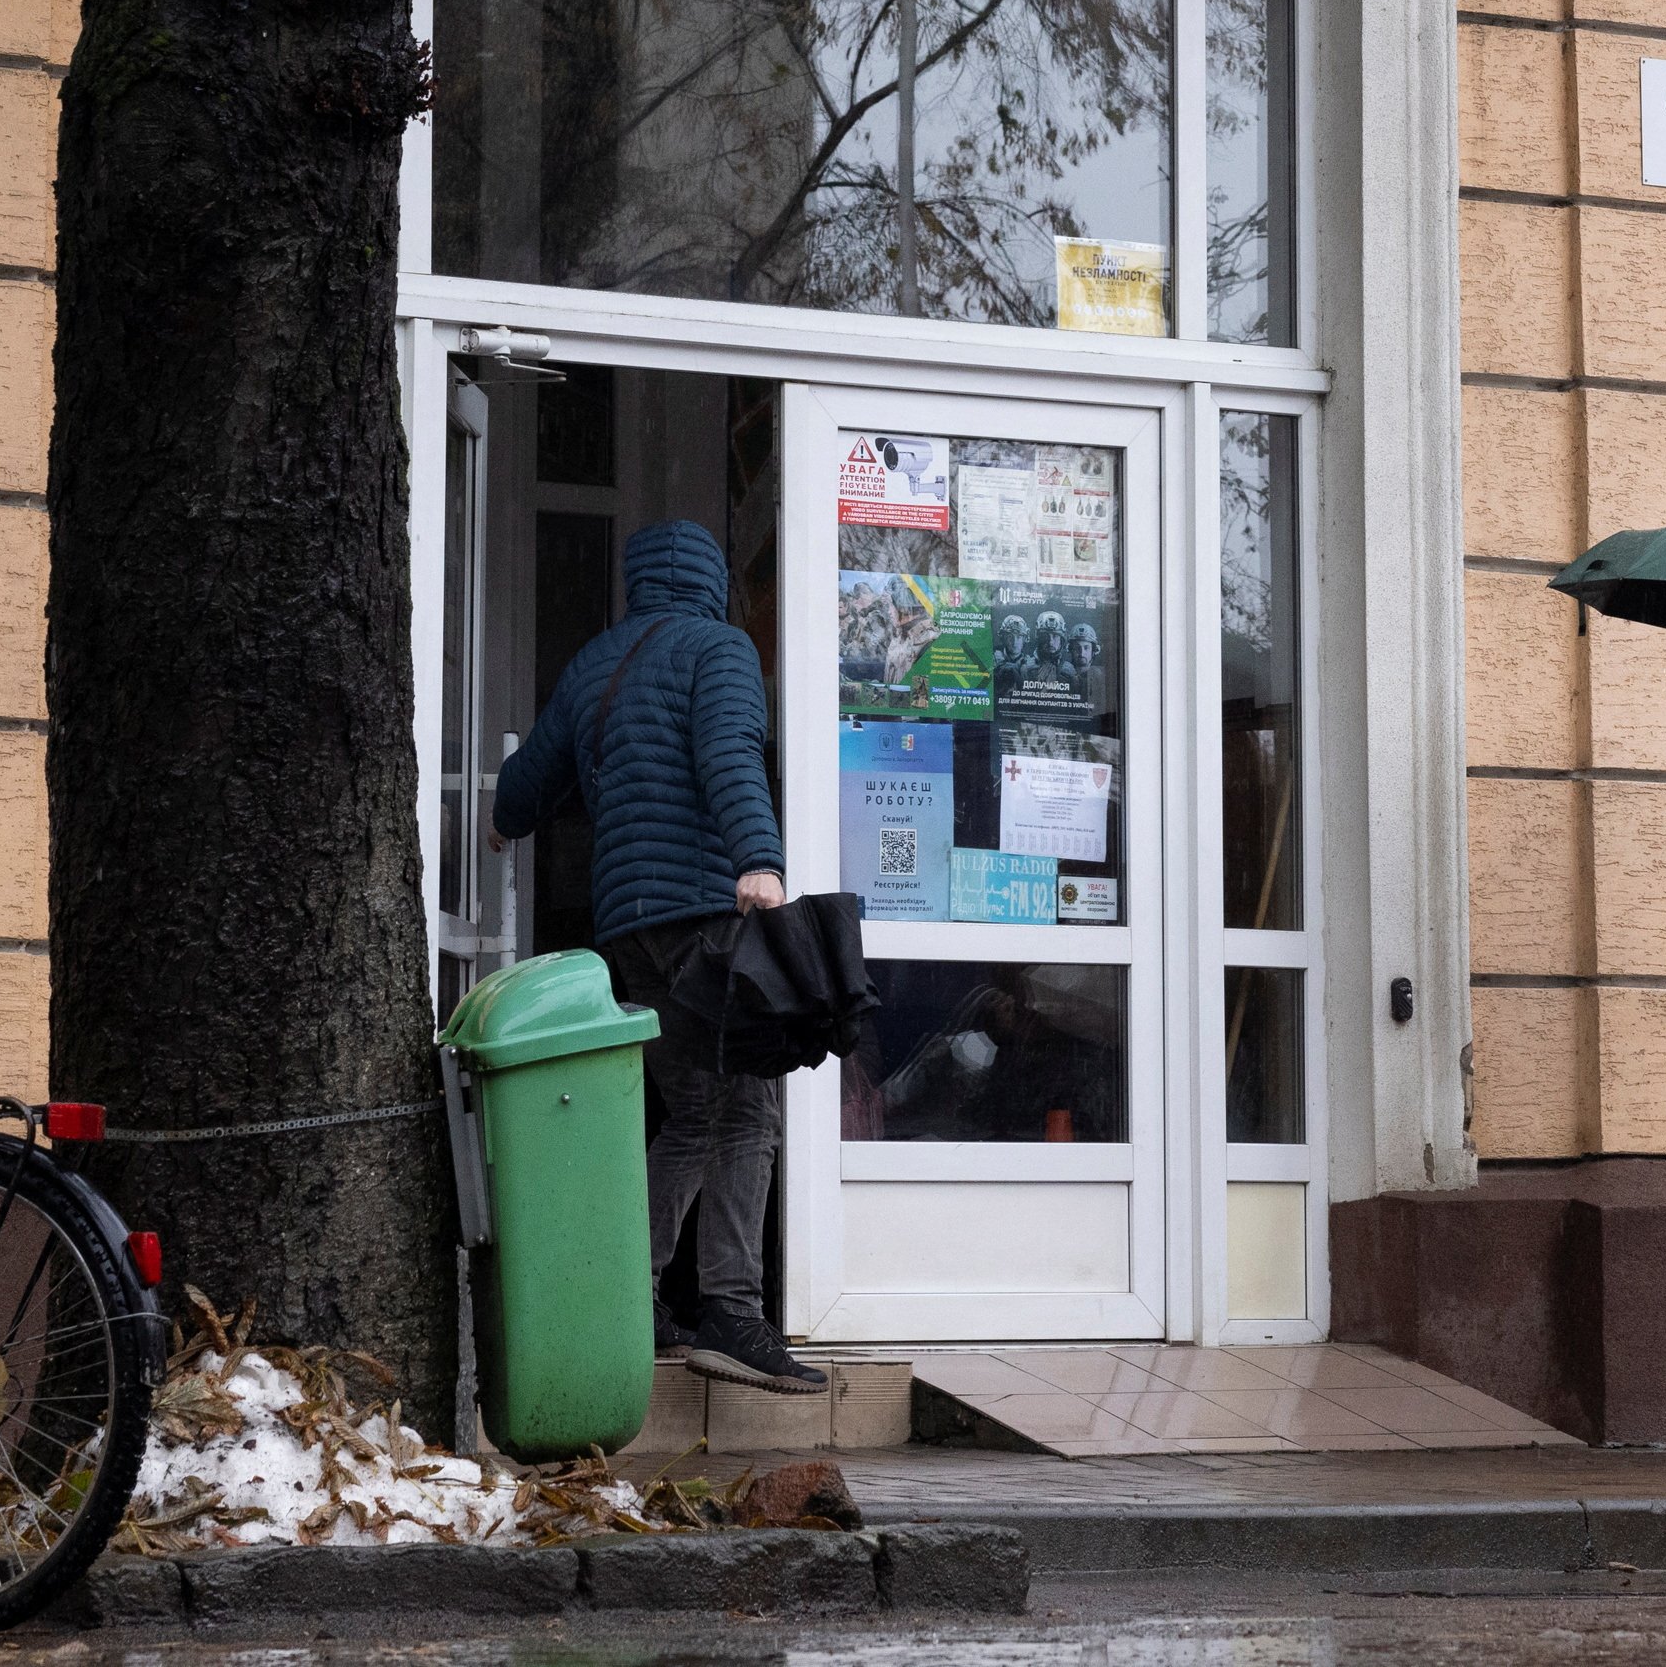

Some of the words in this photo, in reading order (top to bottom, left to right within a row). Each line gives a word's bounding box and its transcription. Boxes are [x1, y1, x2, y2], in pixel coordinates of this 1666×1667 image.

[1093, 254, 1127, 267] ПУНКТ
[1073, 266, 1147, 283] НЕЗЛАМНОСТІ
[840, 464, 885, 476] УВАГА
[840, 475, 885, 484] ATTENTION
[840, 482, 885, 491] FIGYELEM
[840, 489, 885, 498] ВНИМАНИЕ
[940, 611, 982, 620] ЗАПРОШУЄМО
[940, 619, 986, 629] БЕЗКОШТОВНЕ
[940, 627, 974, 636] НАВЧАННЯ
[1023, 680, 1070, 691] ДОЛУЧАЙСЯ
[930, 695, 957, 704] +38097
[958, 696, 972, 705] 717
[972, 697, 991, 706] 0419
[865, 780, 932, 792] ШУКАЄШ
[865, 795, 933, 807] РОБОТУ?
[882, 815, 913, 824] Скануй!
[952, 853, 1006, 873] PULZUS
[1010, 856, 1056, 876] RÁDIÓ
[874, 881, 921, 891] Реєструйся!
[1087, 883, 1108, 892] УВАГА!
[896, 898, 927, 906] необхідну
[1010, 881, 1029, 917] FM
[952, 899, 976, 916] Радіо
